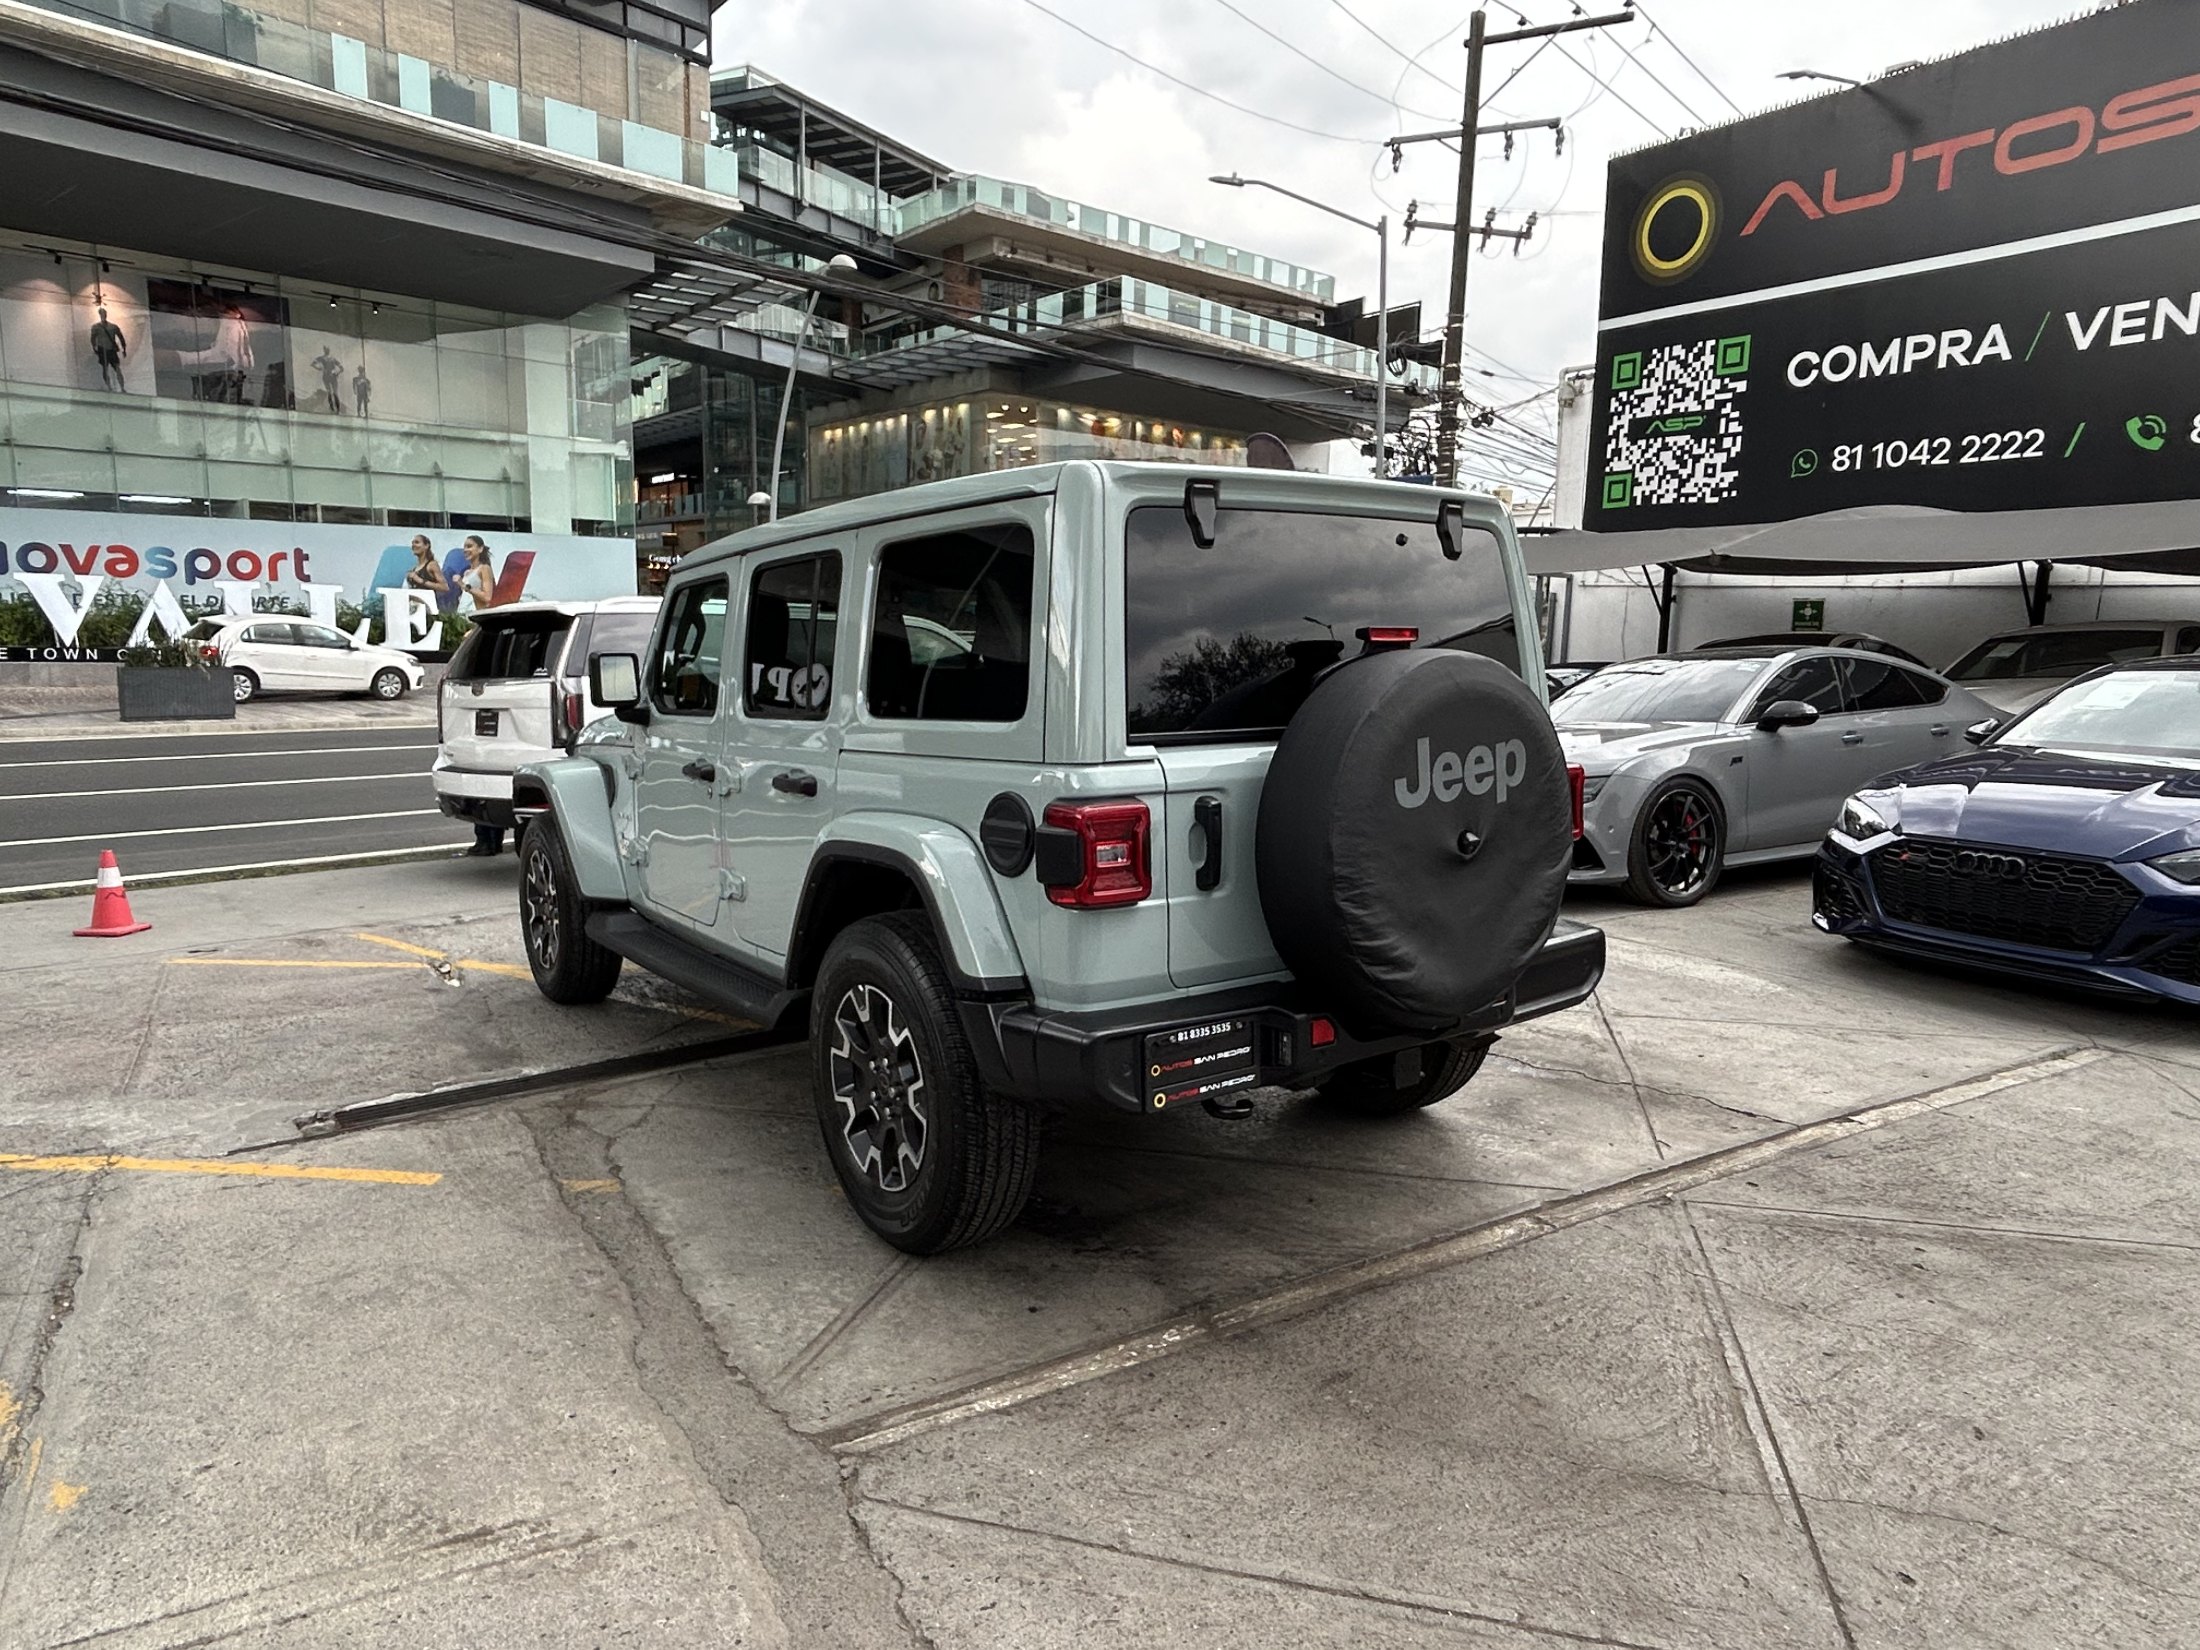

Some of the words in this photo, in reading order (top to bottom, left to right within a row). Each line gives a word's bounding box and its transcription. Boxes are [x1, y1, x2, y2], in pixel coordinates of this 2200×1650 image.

[1740, 74, 2200, 236] AUTOS
[1786, 323, 2012, 387] COMPRA
[2065, 292, 2200, 351] VEN
[1831, 444, 1862, 471] 81
[1872, 437, 1952, 468] 1042
[1960, 428, 2045, 465] 2222
[26, 648, 98, 660] TOWN
[1394, 737, 1526, 808] Jeep
[1177, 1032, 1188, 1041] 81
[1190, 1026, 1210, 1039] 8335
[1211, 1022, 1231, 1034] 3535
[1194, 1054, 1216, 1065] SAN
[1199, 1082, 1221, 1093] SAN
